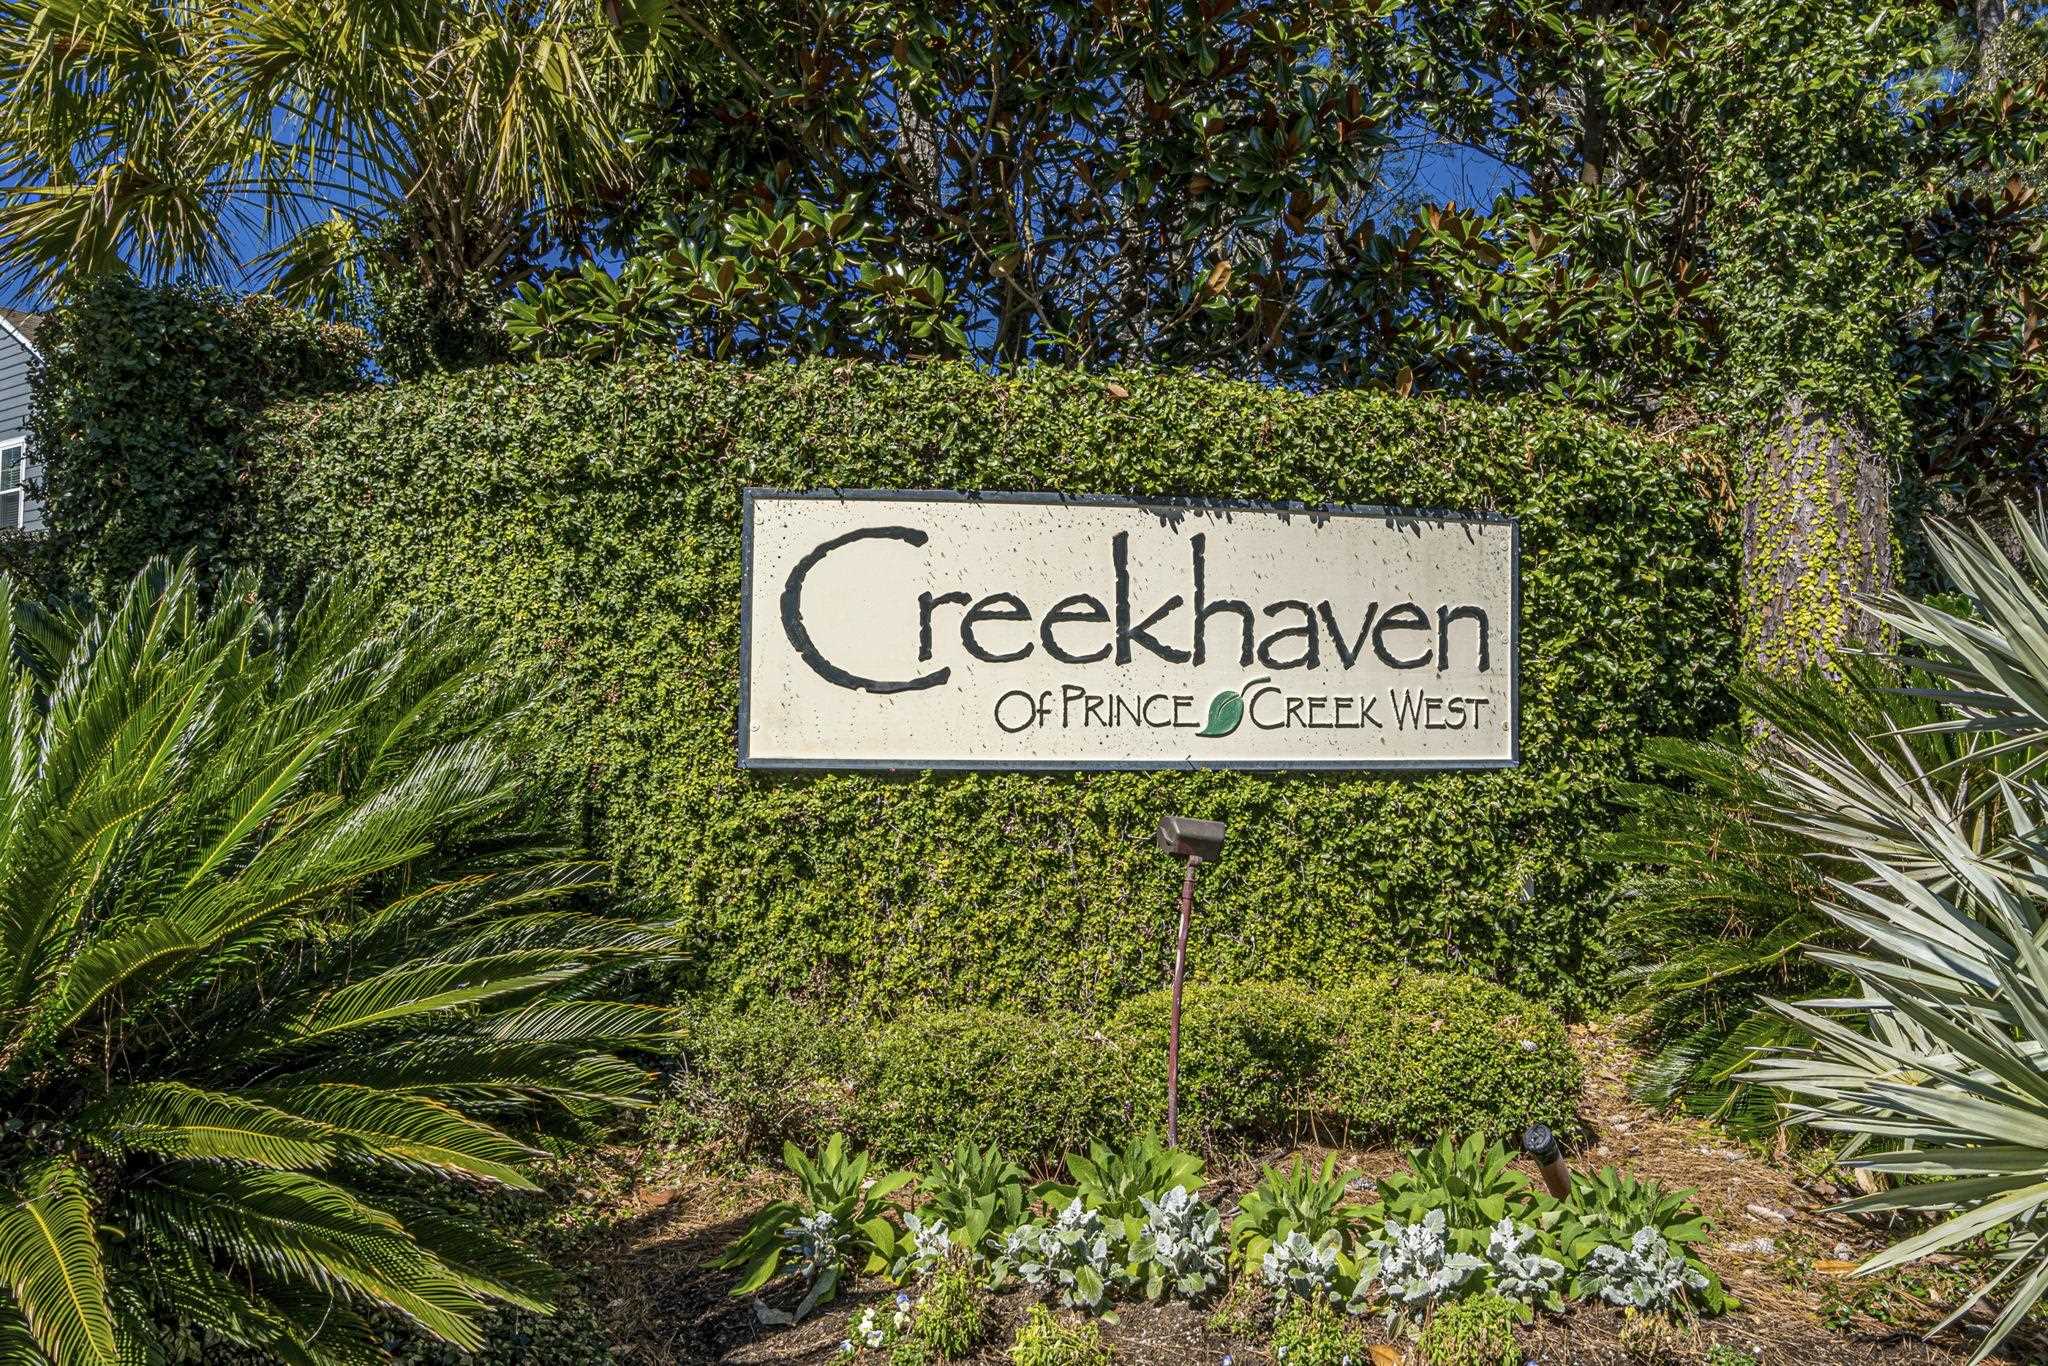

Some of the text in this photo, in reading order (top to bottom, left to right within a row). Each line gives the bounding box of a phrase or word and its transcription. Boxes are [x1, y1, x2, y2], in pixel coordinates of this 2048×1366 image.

[780, 525, 1491, 694] Creekhaven
[1061, 684, 1201, 728] PRINCE
[1249, 686, 1383, 730] CREEK
[1390, 688, 1490, 731] WEST
